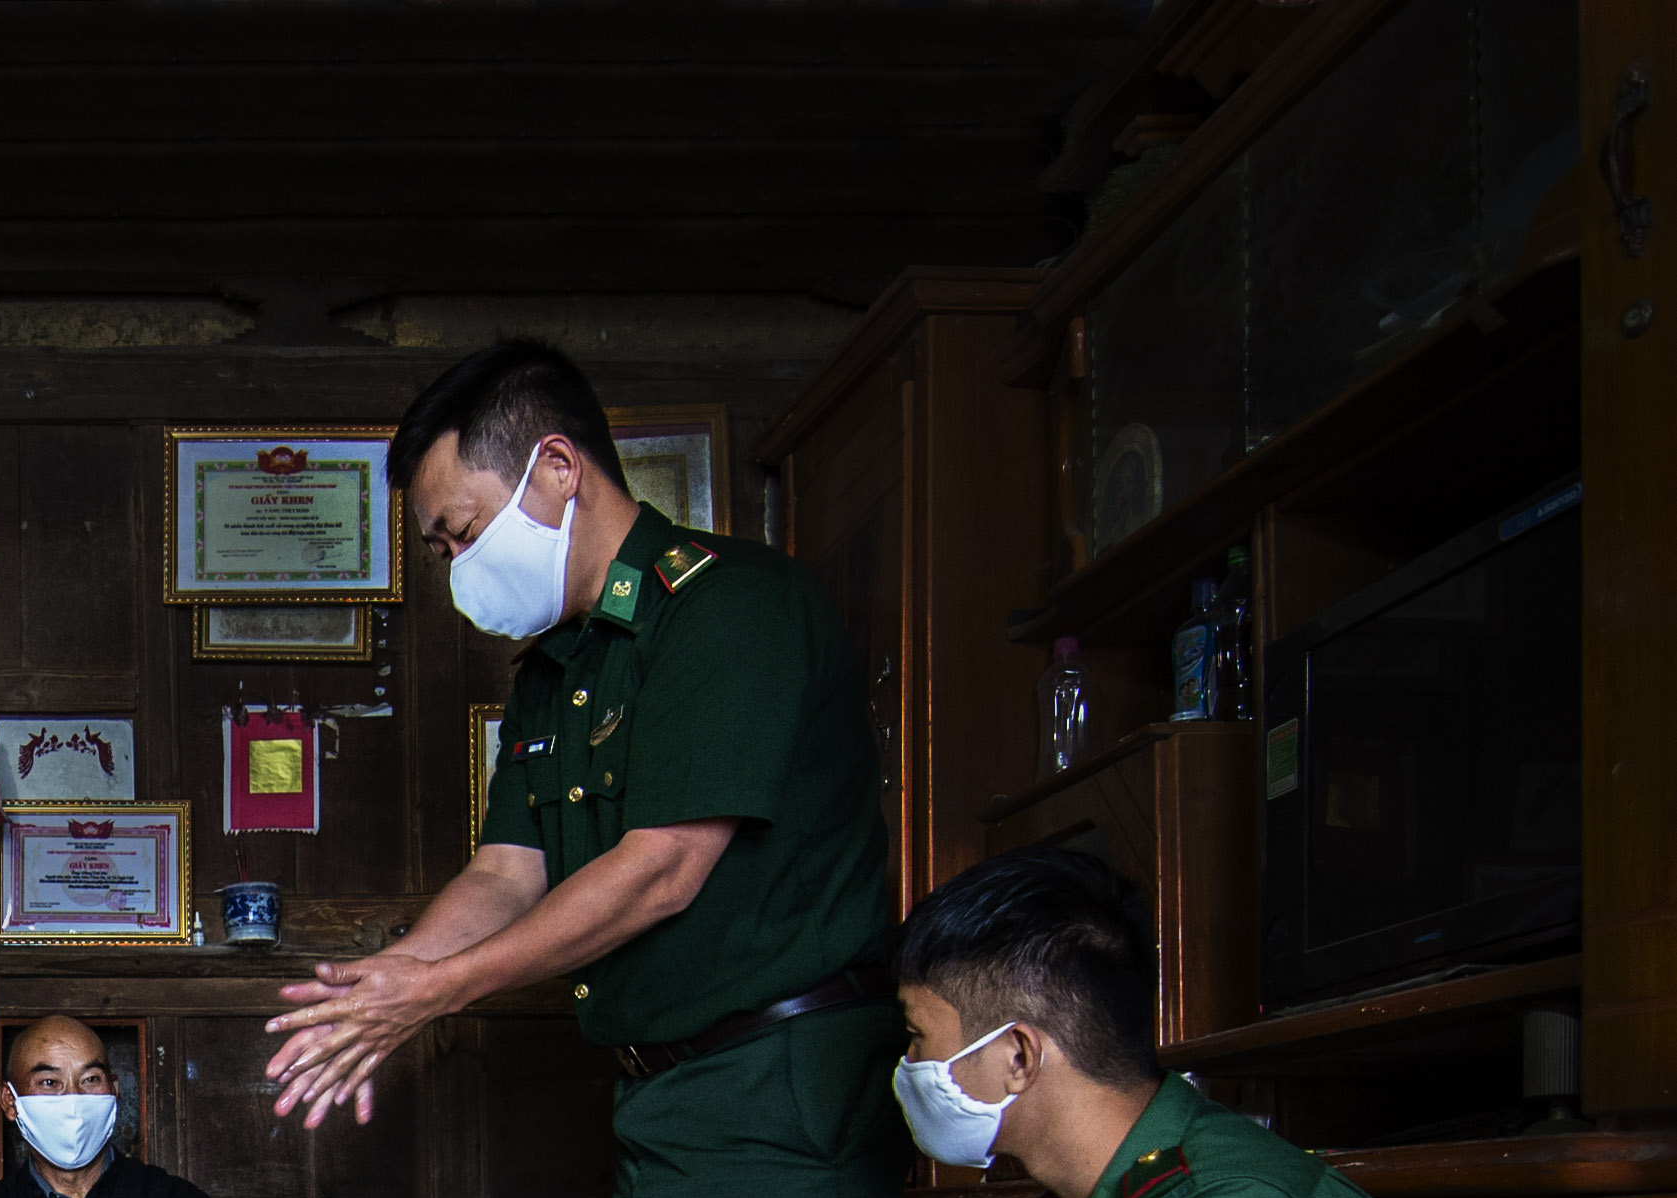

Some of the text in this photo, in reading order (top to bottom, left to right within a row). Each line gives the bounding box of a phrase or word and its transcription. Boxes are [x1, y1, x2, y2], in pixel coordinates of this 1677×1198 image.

[250, 493, 314, 505] GIẤY KHEN
[69, 860, 110, 870] GIẤY KHEN
